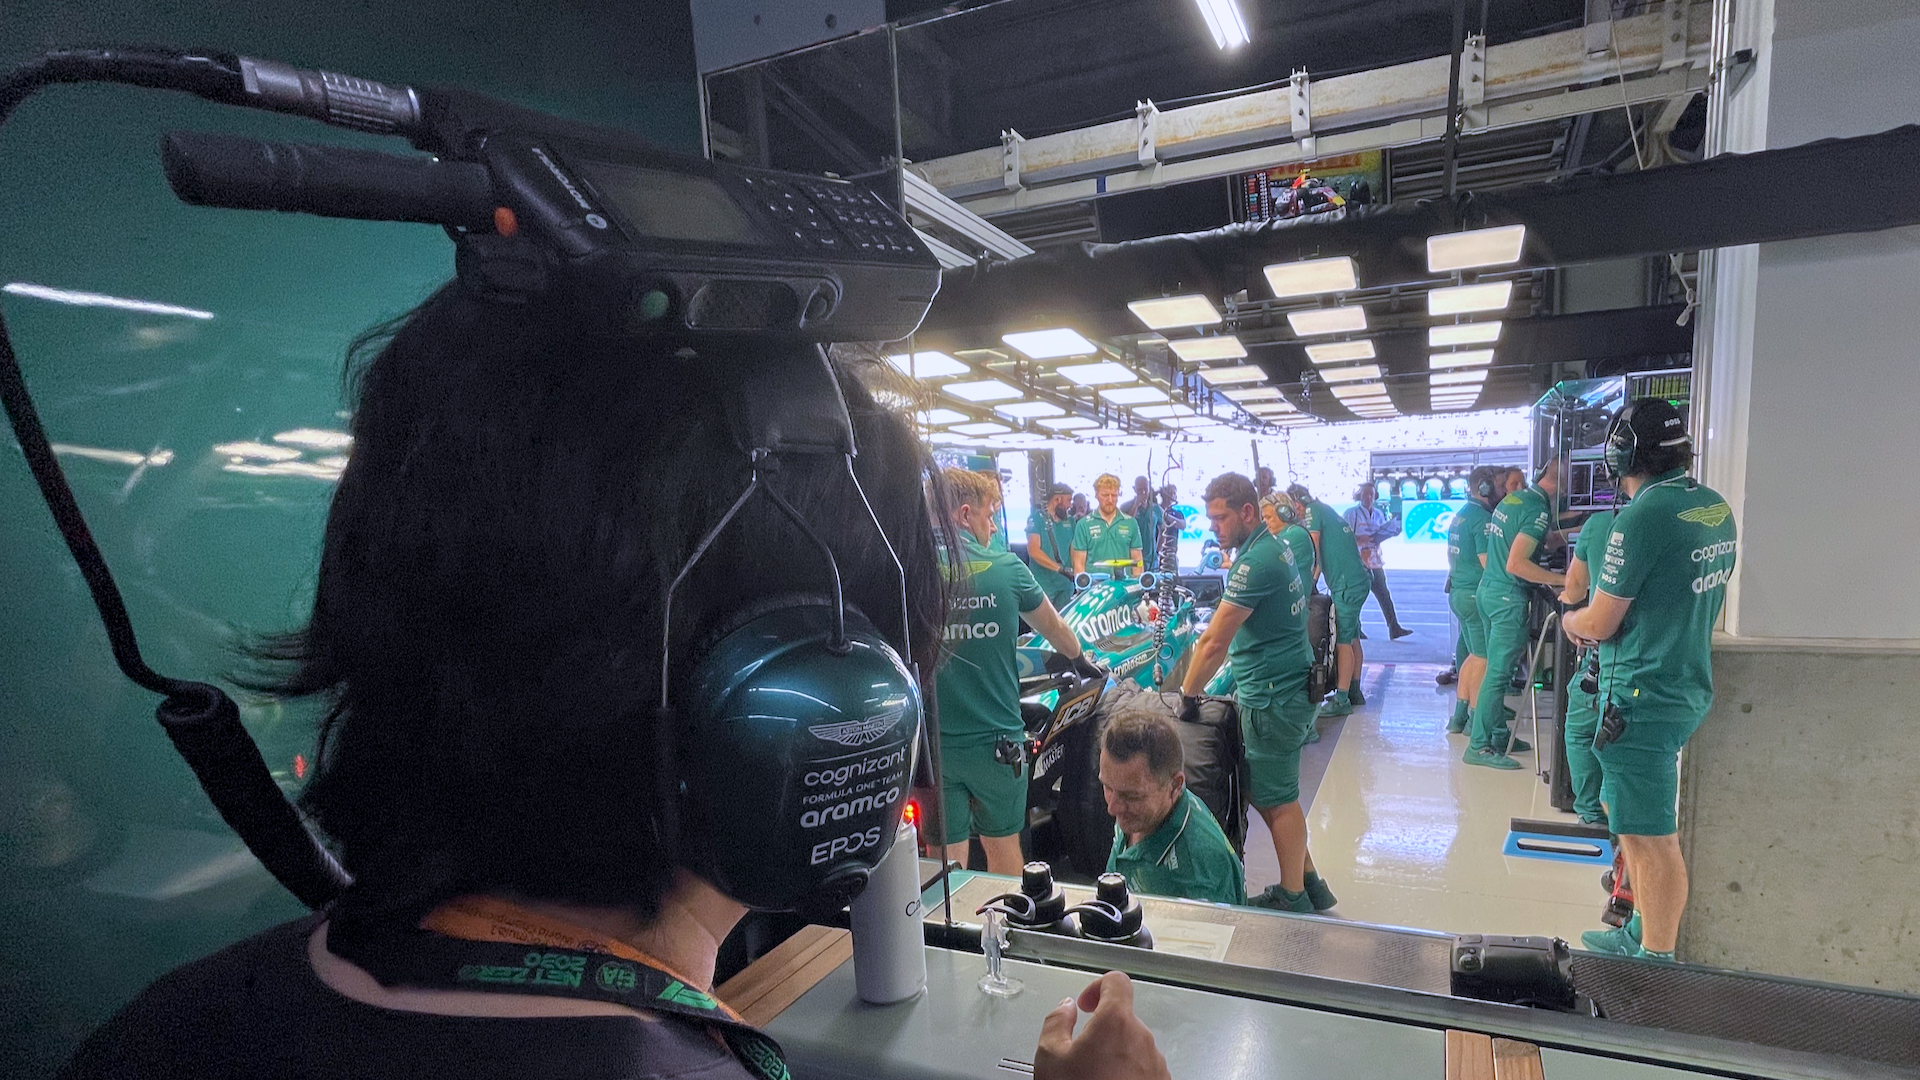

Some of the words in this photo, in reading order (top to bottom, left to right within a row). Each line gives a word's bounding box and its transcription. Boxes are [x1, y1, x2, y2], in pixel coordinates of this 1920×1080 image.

[1664, 417, 1681, 428] BOSS
[1601, 572, 1617, 585] BOSS
[1078, 603, 1132, 644] aramco
[1114, 652, 1148, 677] crypto.com
[841, 726, 862, 736] ASTON
[863, 719, 885, 731] MARTIN
[1052, 695, 1094, 732] JCB
[803, 747, 905, 786] cognizant
[802, 786, 853, 805] FORMULA
[882, 771, 903, 786] TEAM
[800, 786, 900, 828] aramco
[810, 825, 881, 866] EPOS
[523, 952, 587, 972] 2030
[532, 968, 582, 988] NET
